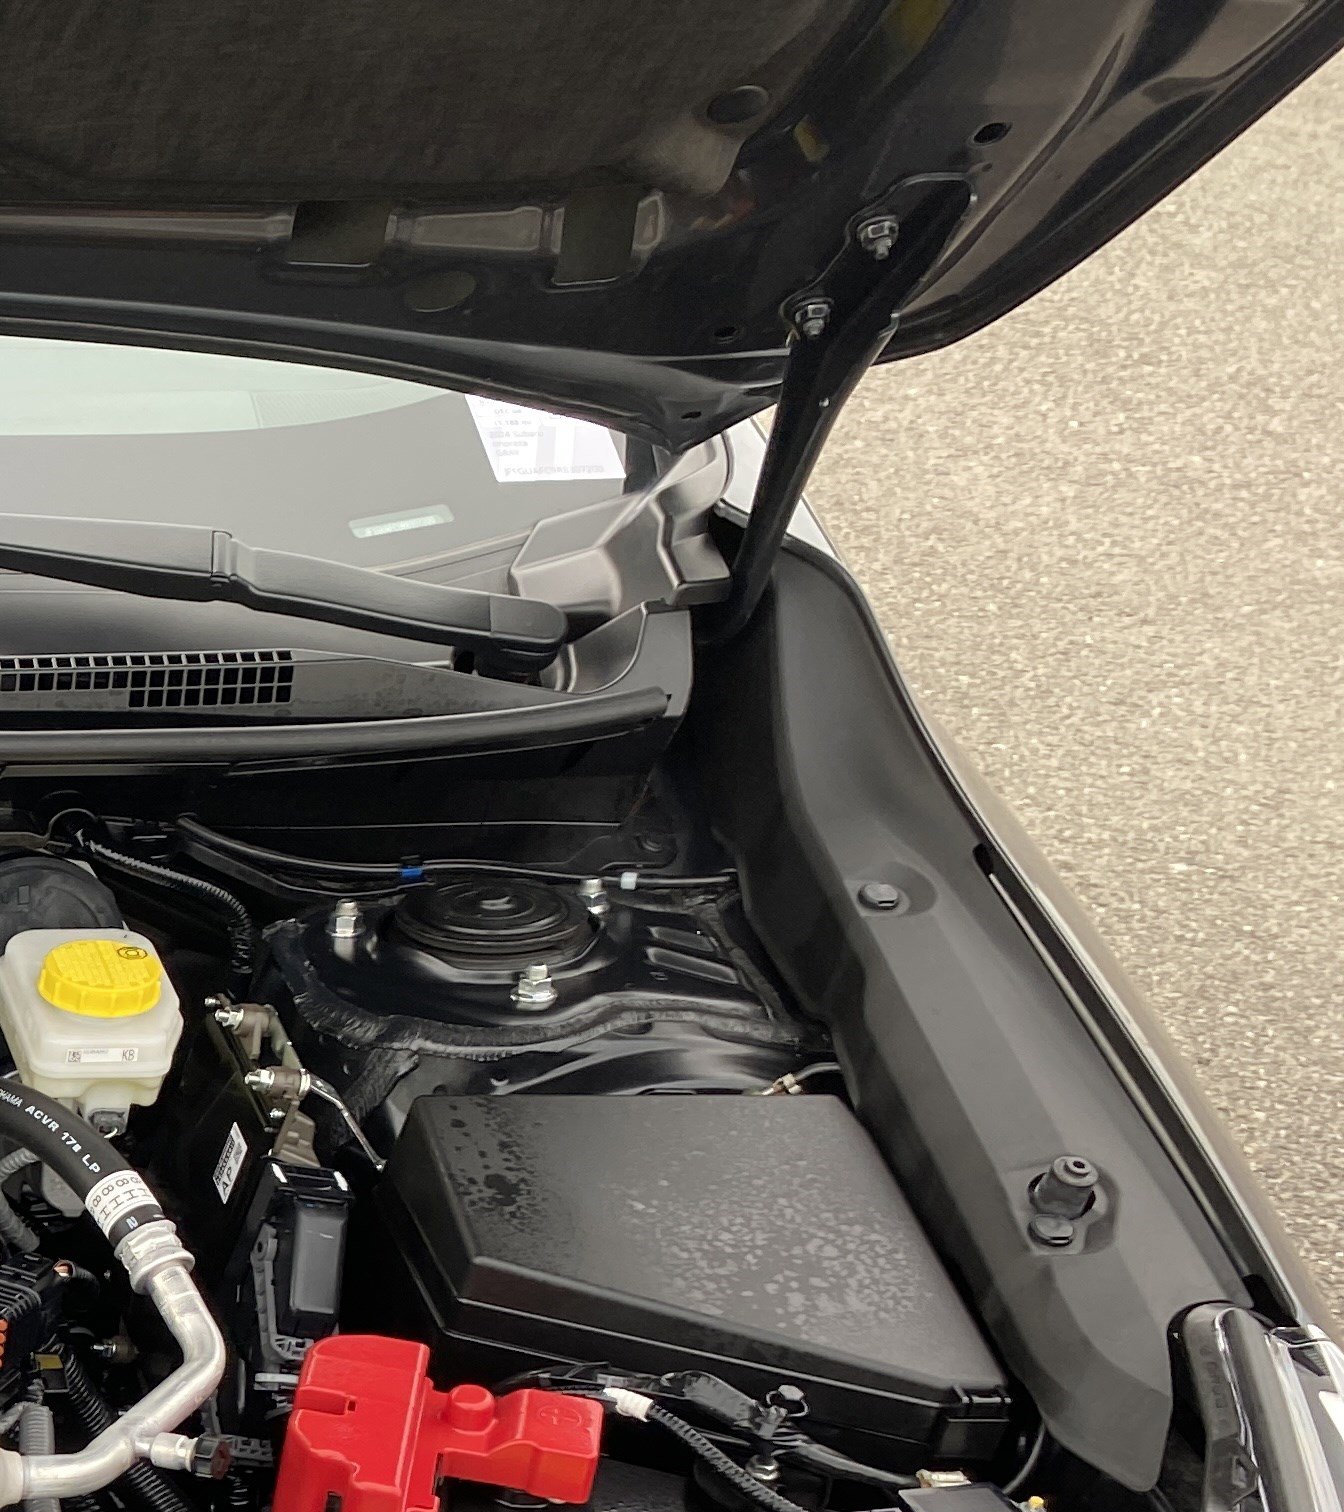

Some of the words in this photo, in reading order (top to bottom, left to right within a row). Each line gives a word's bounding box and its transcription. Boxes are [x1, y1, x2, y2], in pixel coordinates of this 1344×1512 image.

[122, 1049, 136, 1061] KB
[24, 1105, 60, 1132] ACVR
[81, 1154, 101, 1173] LP
[102, 1184, 114, 1196] 8
[110, 1195, 124, 1210] H
[116, 1178, 130, 1188] 8
[123, 1189, 139, 1202] H
